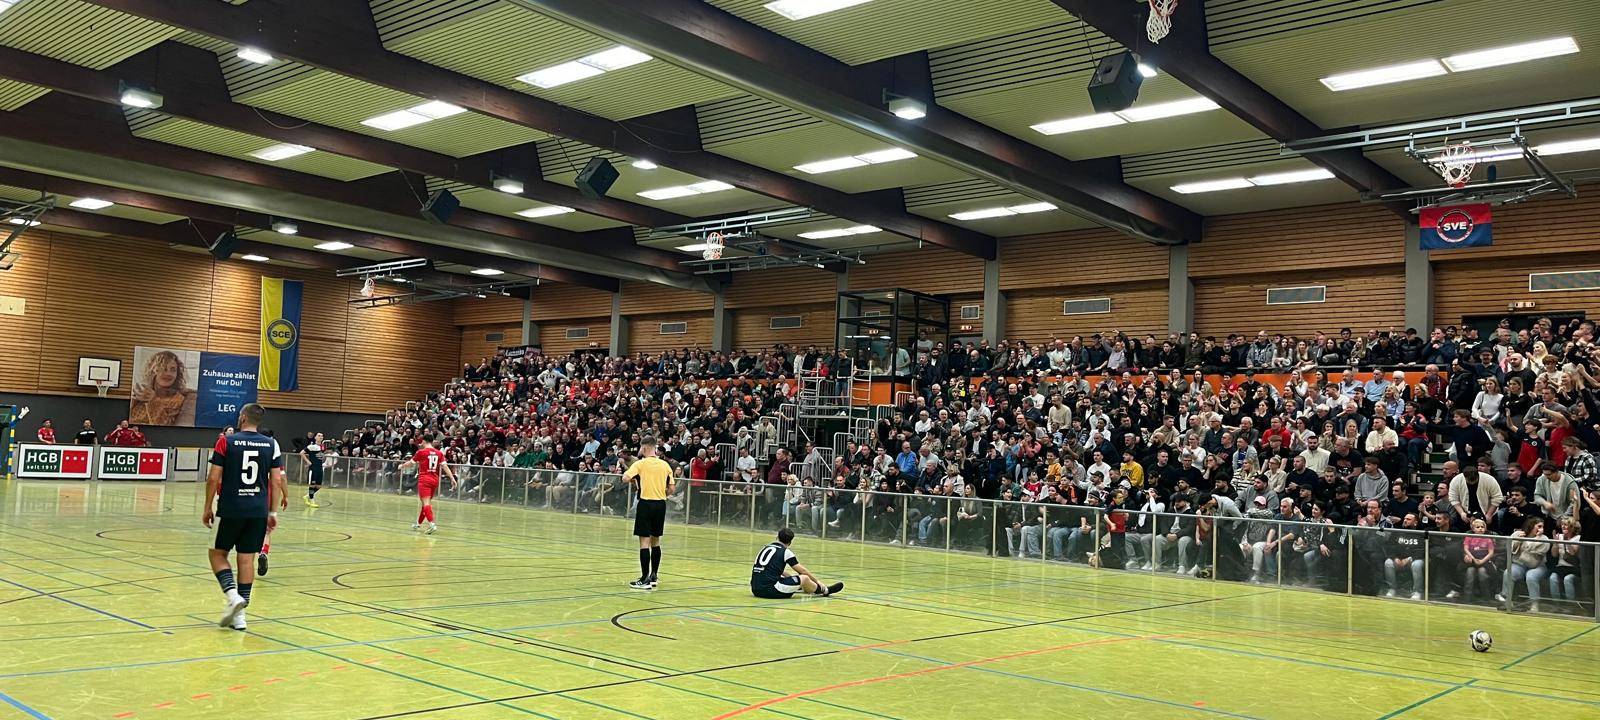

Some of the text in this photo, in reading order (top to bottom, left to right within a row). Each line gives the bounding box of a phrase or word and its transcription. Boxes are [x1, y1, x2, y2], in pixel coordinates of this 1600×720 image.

[1443, 221, 1467, 231] SVE
[271, 330, 291, 339] SCE
[202, 369, 256, 380] Zuhause zählst
[230, 379, 242, 387] Du!
[218, 403, 236, 412] LEG
[26, 451, 58, 463] HGB
[106, 454, 136, 465] HGB
[427, 454, 439, 470] 19
[241, 450, 259, 485] 5
